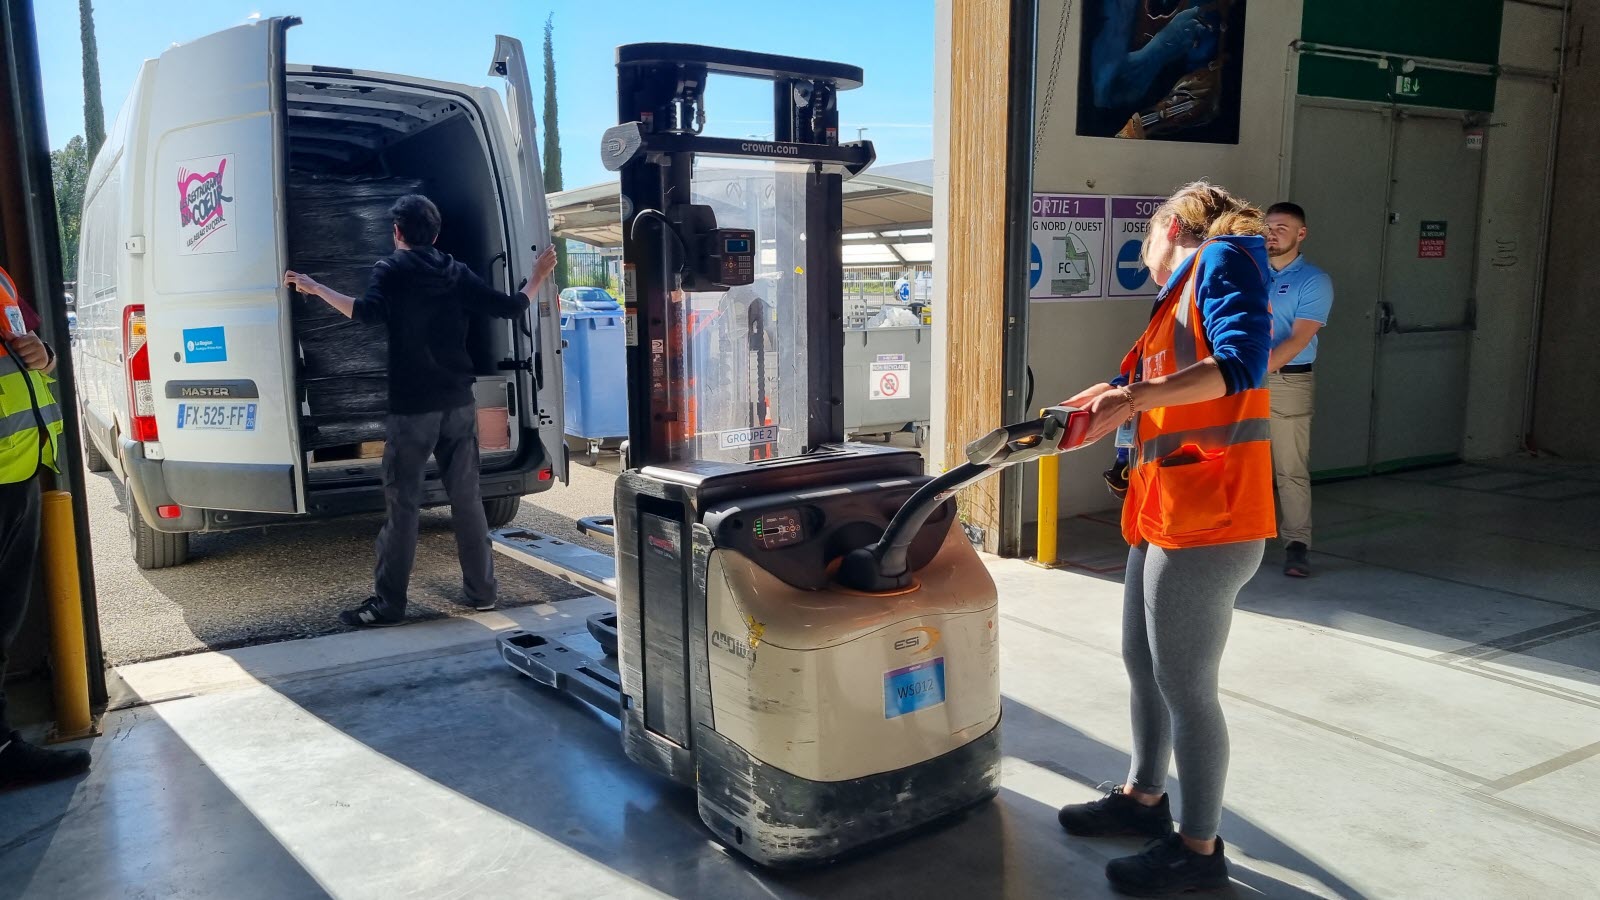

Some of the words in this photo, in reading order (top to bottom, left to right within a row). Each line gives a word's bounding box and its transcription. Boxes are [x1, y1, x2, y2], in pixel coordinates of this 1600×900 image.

[741, 142, 798, 155] crown.com
[1032, 199, 1070, 214] ORTIE
[1074, 200, 1080, 214] 1
[1032, 222, 1039, 231] G
[1041, 222, 1066, 231] NORD
[1075, 222, 1103, 231] OUEST
[1058, 262, 1071, 274] FC
[181, 387, 230, 396] MASTER
[185, 406, 246, 426] FX-525-FF
[767, 429, 773, 439] 2
[897, 679, 934, 699] WS012
